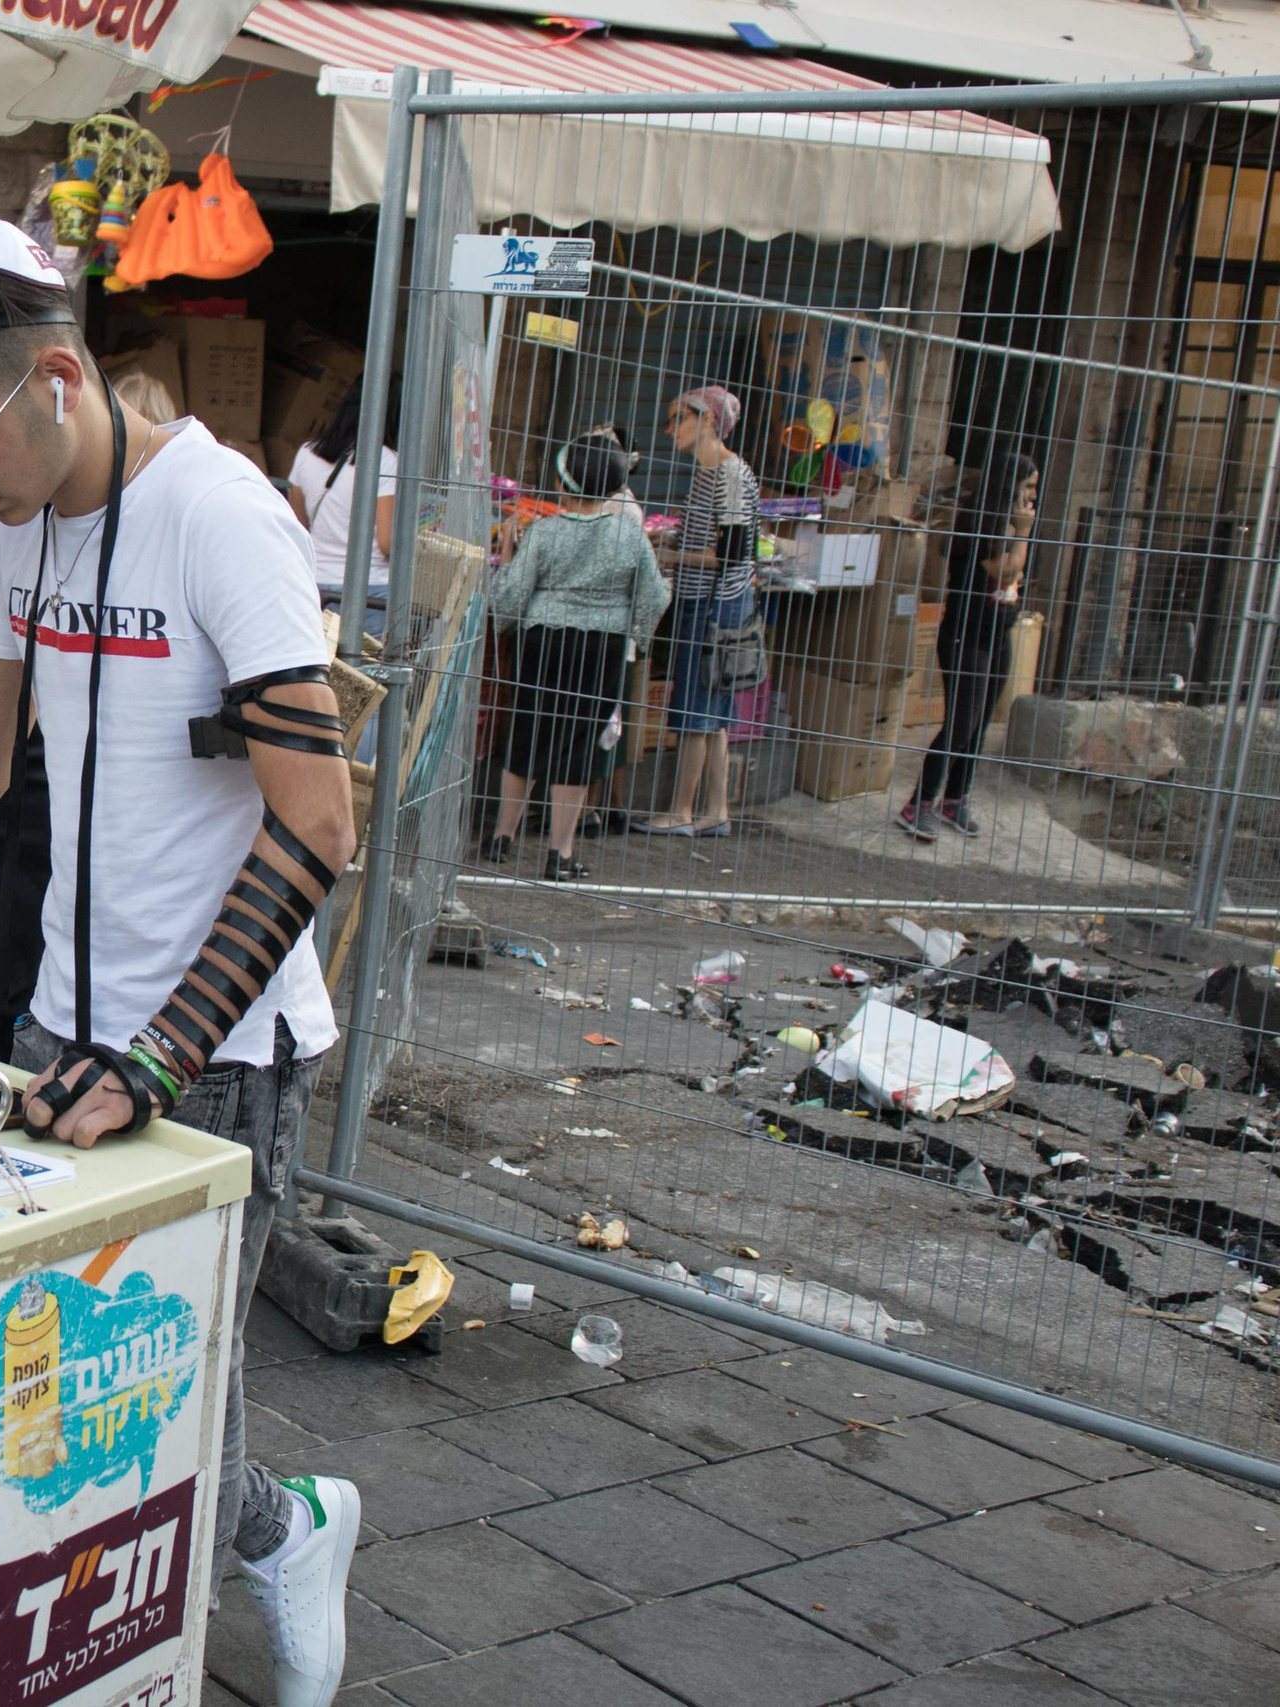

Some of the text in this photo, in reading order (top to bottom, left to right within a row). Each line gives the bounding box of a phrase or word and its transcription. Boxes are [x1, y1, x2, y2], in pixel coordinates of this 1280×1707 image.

[12, 1377, 50, 1410] צדקה
[13, 1352, 50, 1384] קופת
[76, 1322, 177, 1398] נותנים
[81, 1367, 176, 1451] צדקה
[15, 1516, 180, 1666] חב"ד
[18, 1603, 165, 1699] כל הלב לכל אחד
